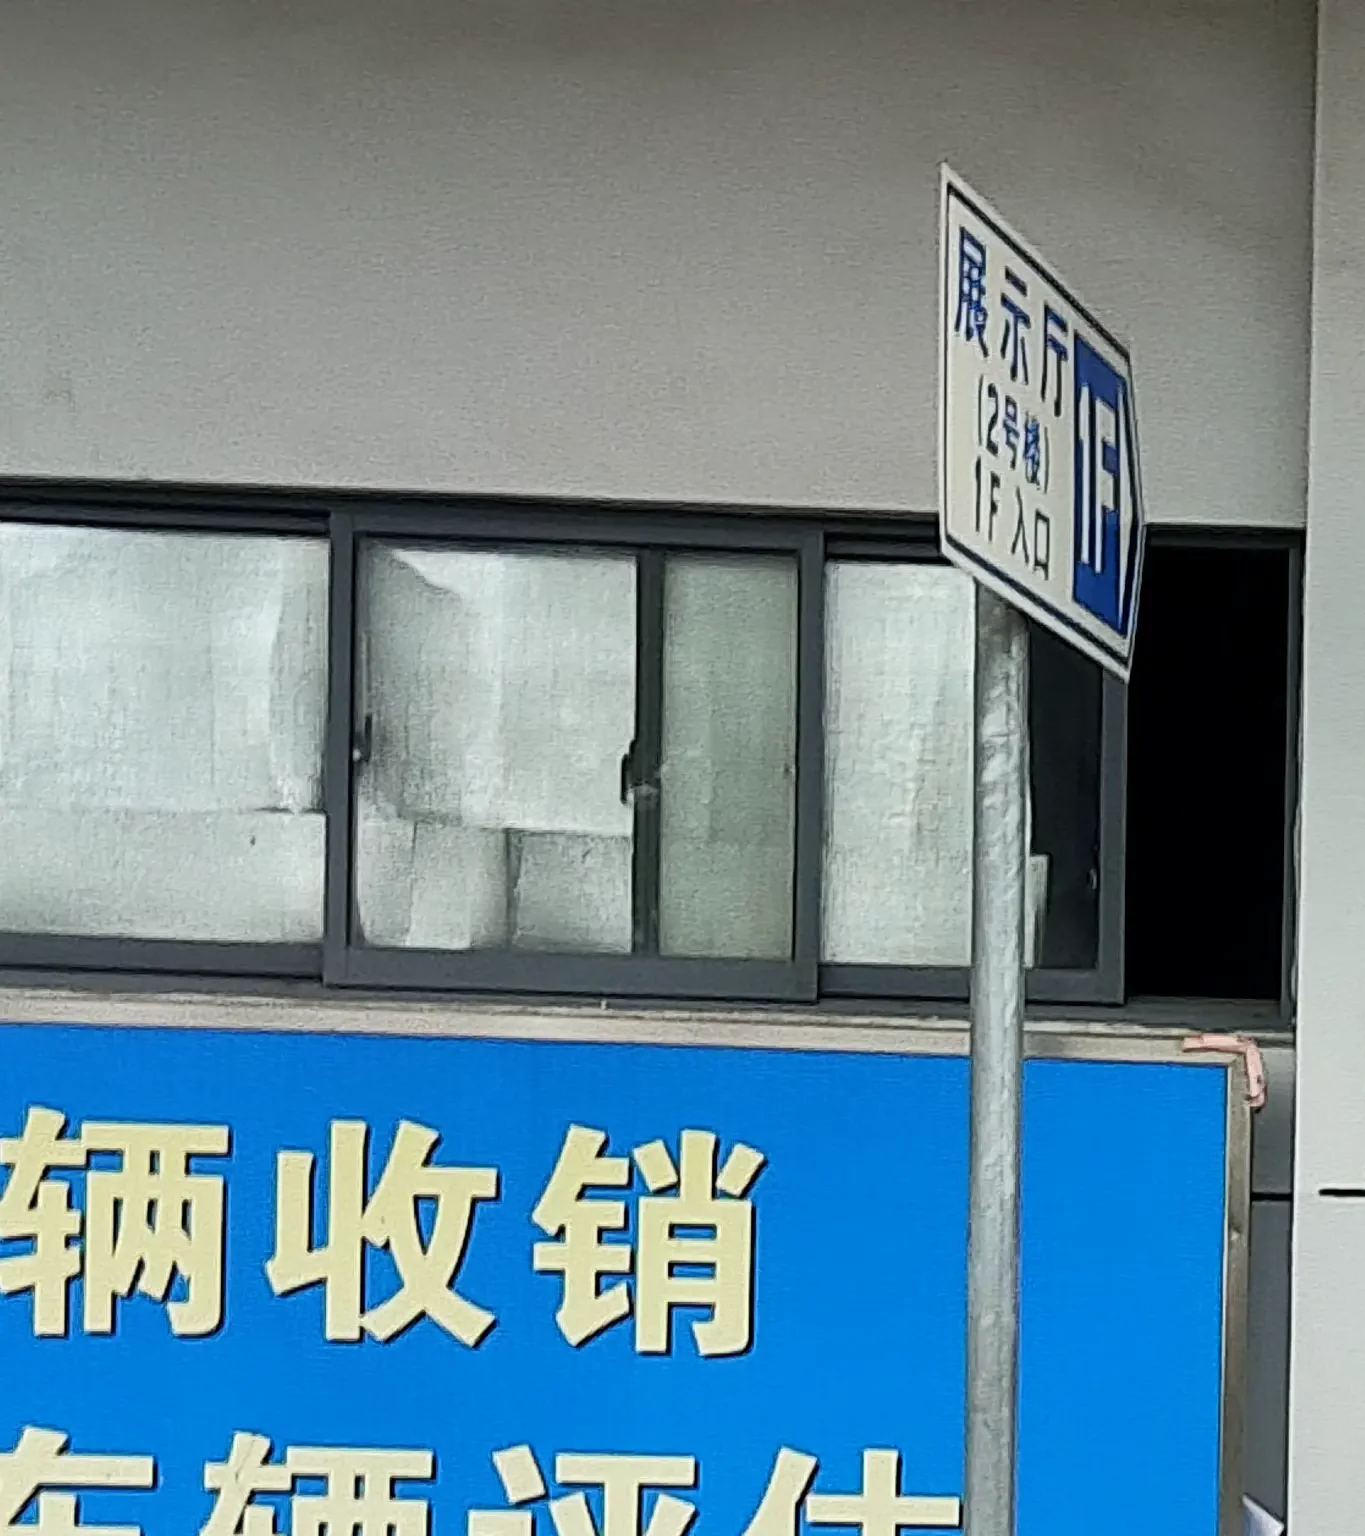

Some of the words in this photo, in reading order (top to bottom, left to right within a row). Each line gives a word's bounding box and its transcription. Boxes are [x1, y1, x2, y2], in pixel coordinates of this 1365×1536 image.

[953, 226, 1069, 417] 展示厅
[1079, 382, 1119, 575] 1F
[0, 1105, 764, 1357] 辆收销
